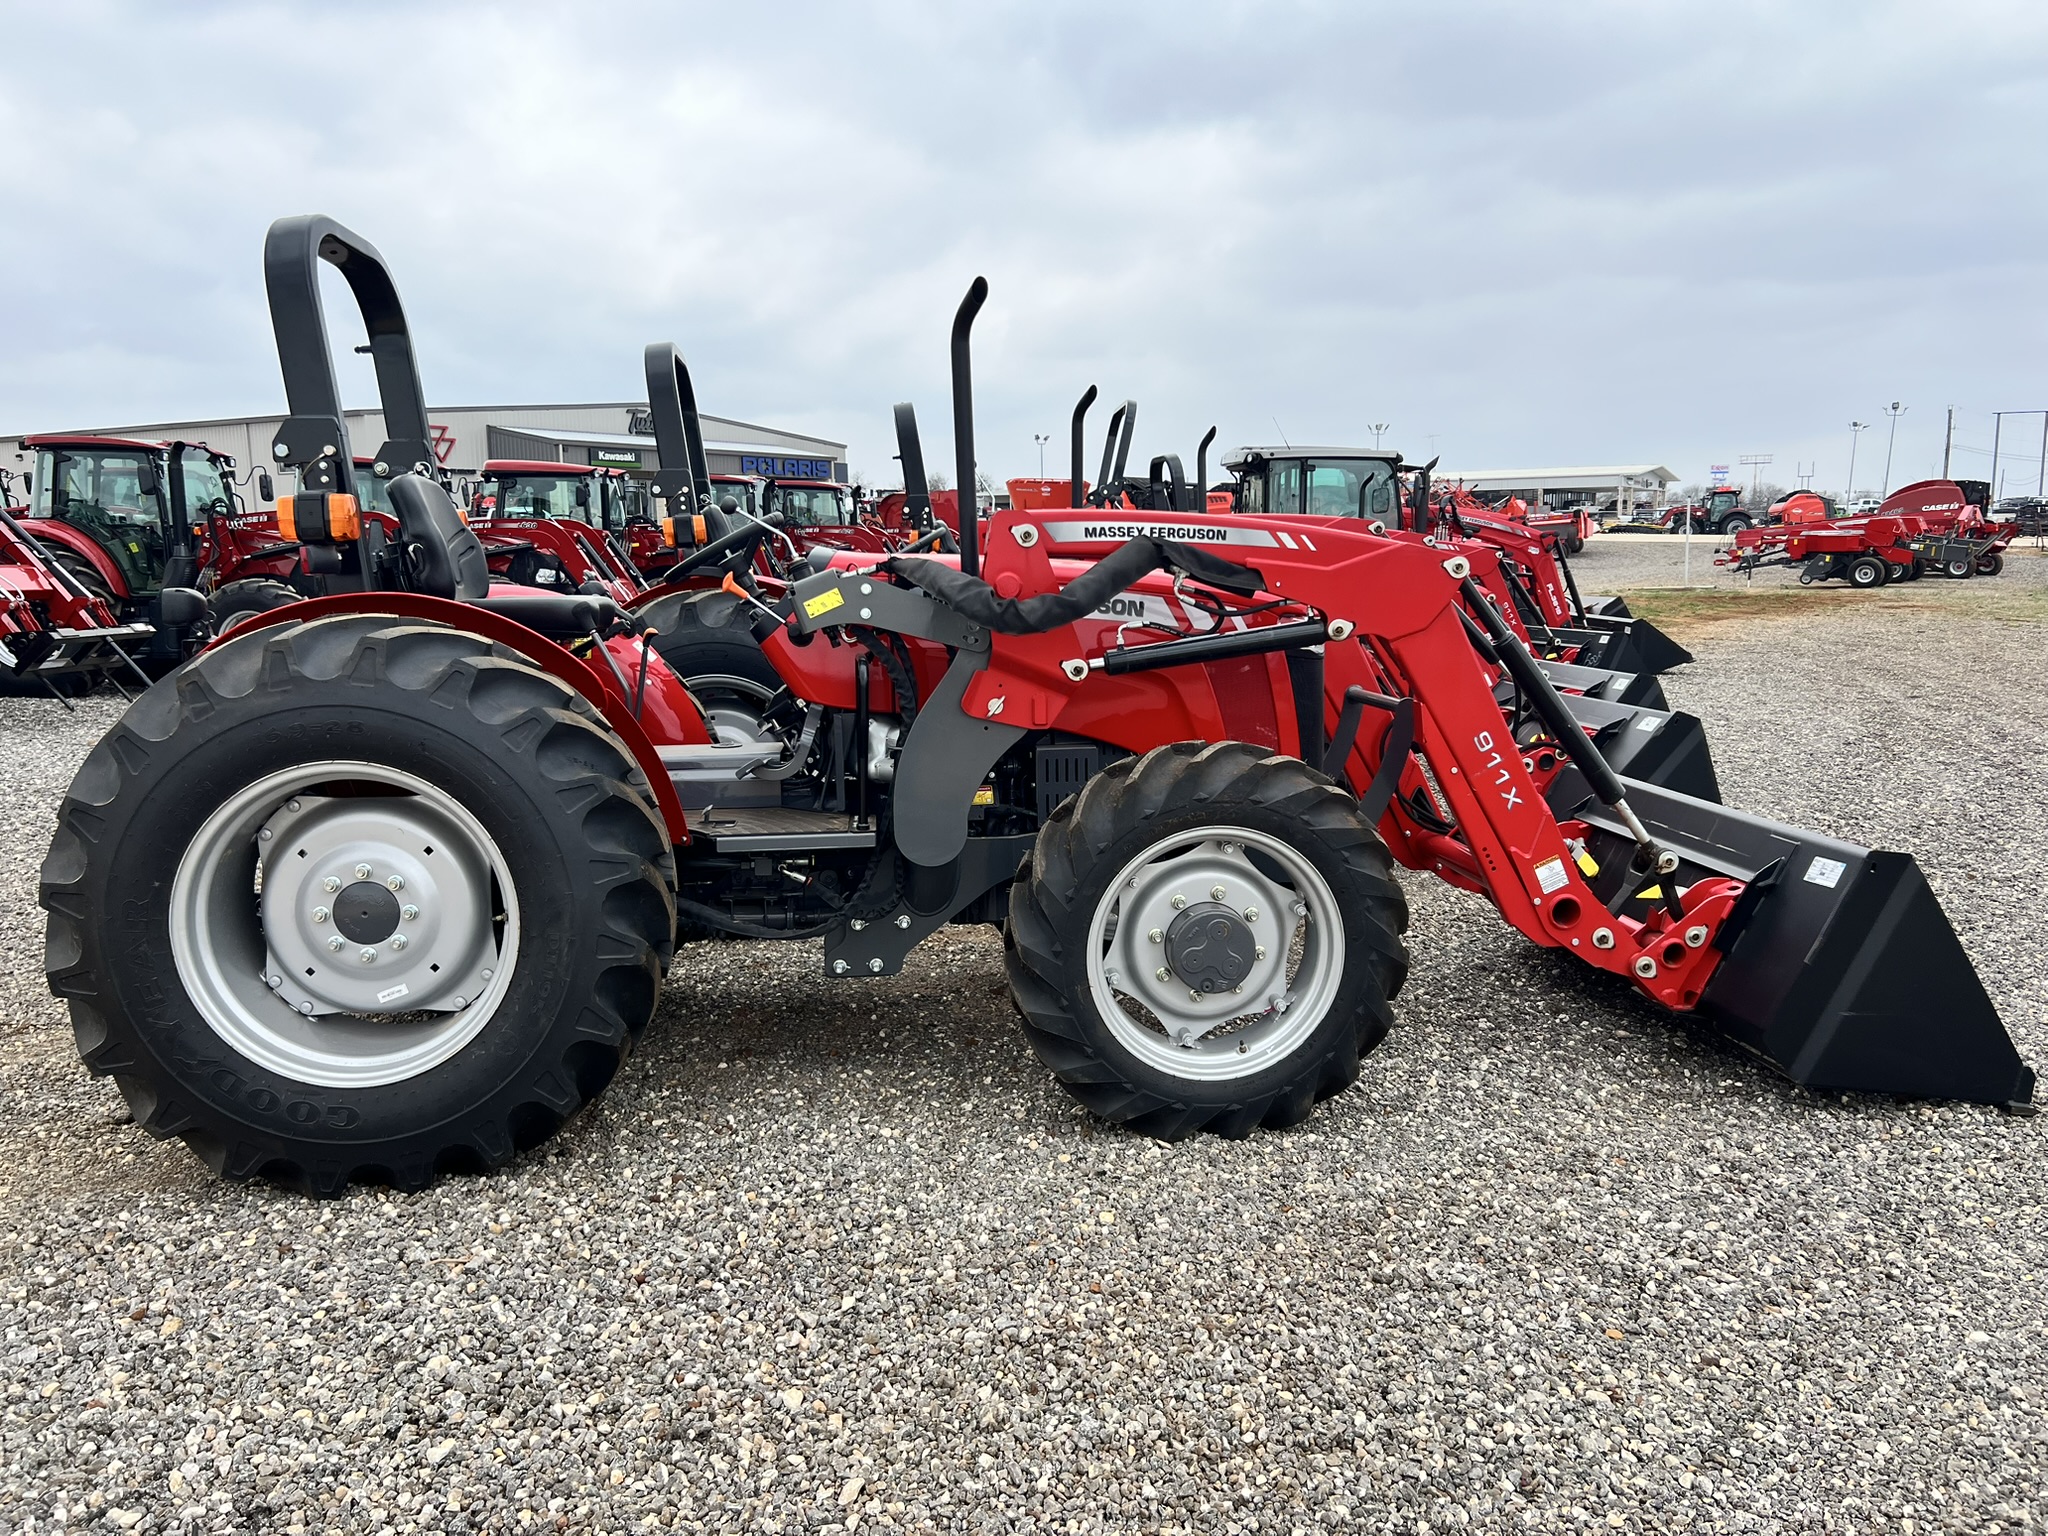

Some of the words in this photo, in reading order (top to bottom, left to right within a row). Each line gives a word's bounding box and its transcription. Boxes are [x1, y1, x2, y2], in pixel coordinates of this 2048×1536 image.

[598, 451, 636, 461] Kawasaki
[741, 456, 831, 477] POLARIS
[1084, 526, 1145, 538] MASSEY
[1150, 527, 1228, 541] FERGUSON
[1474, 731, 1523, 811] 911X
